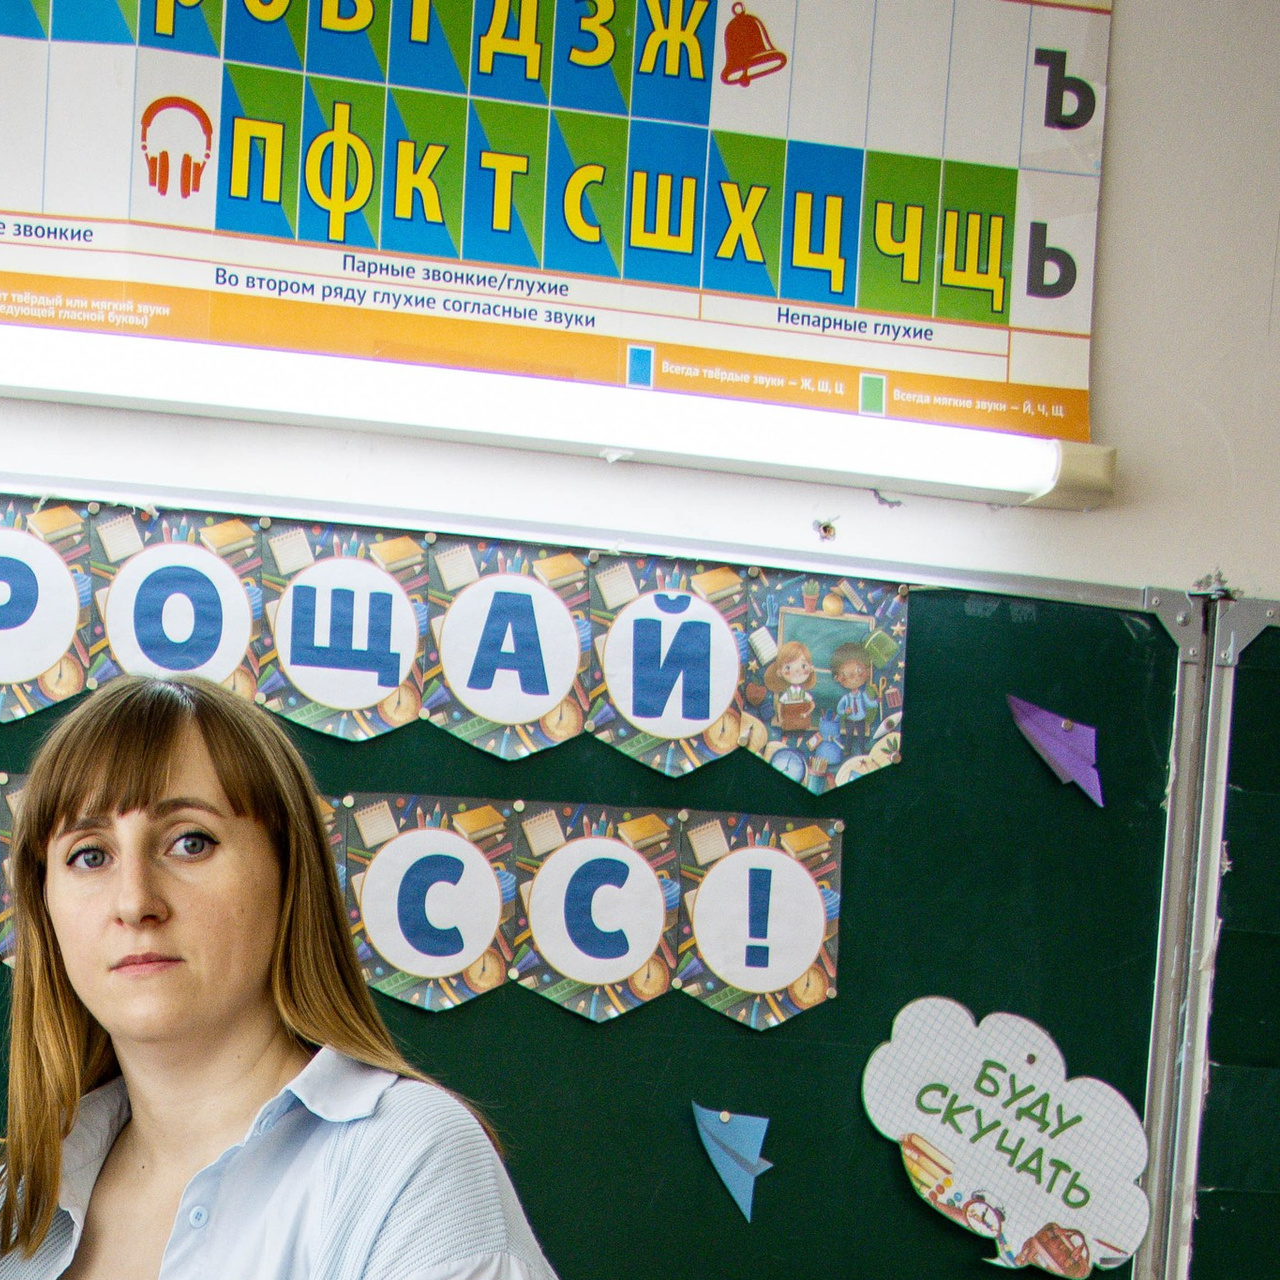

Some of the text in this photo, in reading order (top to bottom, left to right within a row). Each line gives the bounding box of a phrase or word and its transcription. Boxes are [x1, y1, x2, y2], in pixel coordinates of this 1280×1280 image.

[12, 222, 94, 243] звонкие
[342, 254, 570, 298] Парные звонкие/глухие
[11, 290, 63, 310] твёрдый
[65, 296, 88, 309] или
[91, 297, 134, 314] мягкий
[137, 302, 170, 318] звуки
[215, 267, 596, 330] Во втором ряду глухие согласные звуки
[58, 308, 105, 323] гласной
[107, 312, 149, 328] буквы)
[777, 306, 934, 342] Непарные глухие
[661, 361, 699, 377] Всегда
[702, 366, 750, 384] твёрдые
[753, 374, 785, 390] звуки
[893, 388, 930, 404] Всегда
[933, 395, 972, 409] мягкие
[975, 399, 1007, 414] звуки
[974, 1059, 1083, 1139] БУДУ
[916, 1083, 1091, 1209] СКУЧАТЬ
